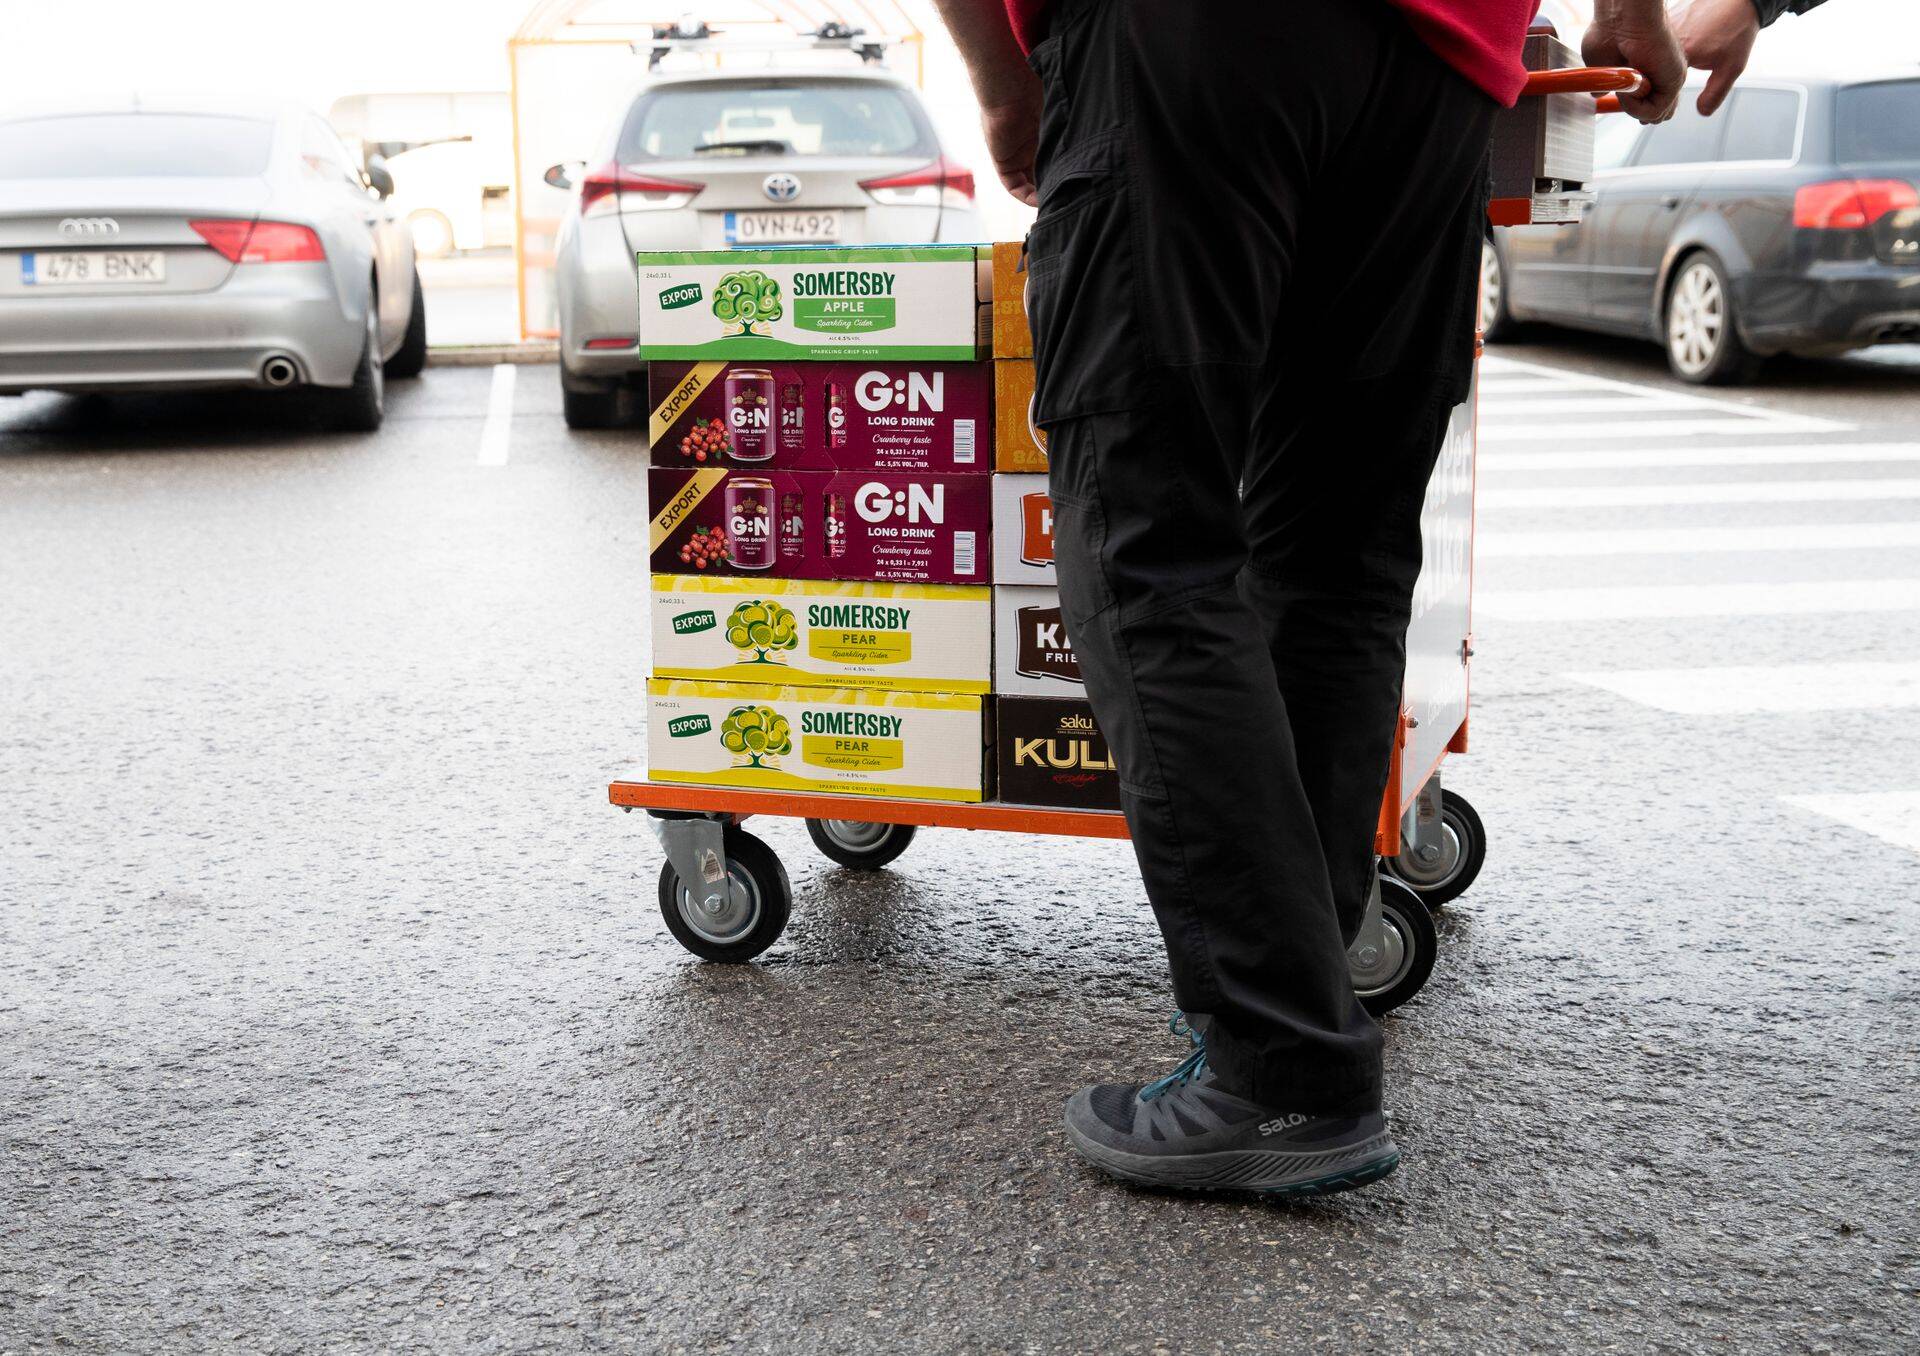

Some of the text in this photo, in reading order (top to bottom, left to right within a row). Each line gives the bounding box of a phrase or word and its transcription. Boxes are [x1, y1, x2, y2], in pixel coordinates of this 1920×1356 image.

[742, 215, 835, 237] OVN-492
[47, 253, 89, 279] 478
[104, 252, 156, 278] BNK
[793, 271, 896, 296] SOMERSBY
[661, 286, 701, 306] EXPORT
[823, 301, 865, 313] APPLE
[816, 318, 874, 330] Sparkling Cider
[659, 374, 702, 424] EXPORT
[854, 370, 945, 412] G:N
[730, 407, 770, 428] G:N
[867, 416, 935, 427] LONG DRINK
[872, 434, 932, 446] Cranberry taste
[659, 482, 702, 531] EXPORT
[854, 481, 945, 524] G:N
[730, 516, 770, 536] G:N
[867, 527, 936, 538] LONG DRINK
[872, 544, 933, 557] Cranberry taste
[674, 613, 714, 631] EXPORT
[808, 604, 911, 630] SOMERSBY
[842, 633, 877, 645] PEAR
[832, 650, 868, 660] Sparkling
[670, 718, 710, 734] EXPORT
[801, 711, 903, 738] SOMERSBY
[1060, 713, 1093, 729] saku
[835, 740, 869, 752] PEAR
[825, 756, 881, 767] Sparkling Cider
[819, 783, 850, 791] SPARKLING
